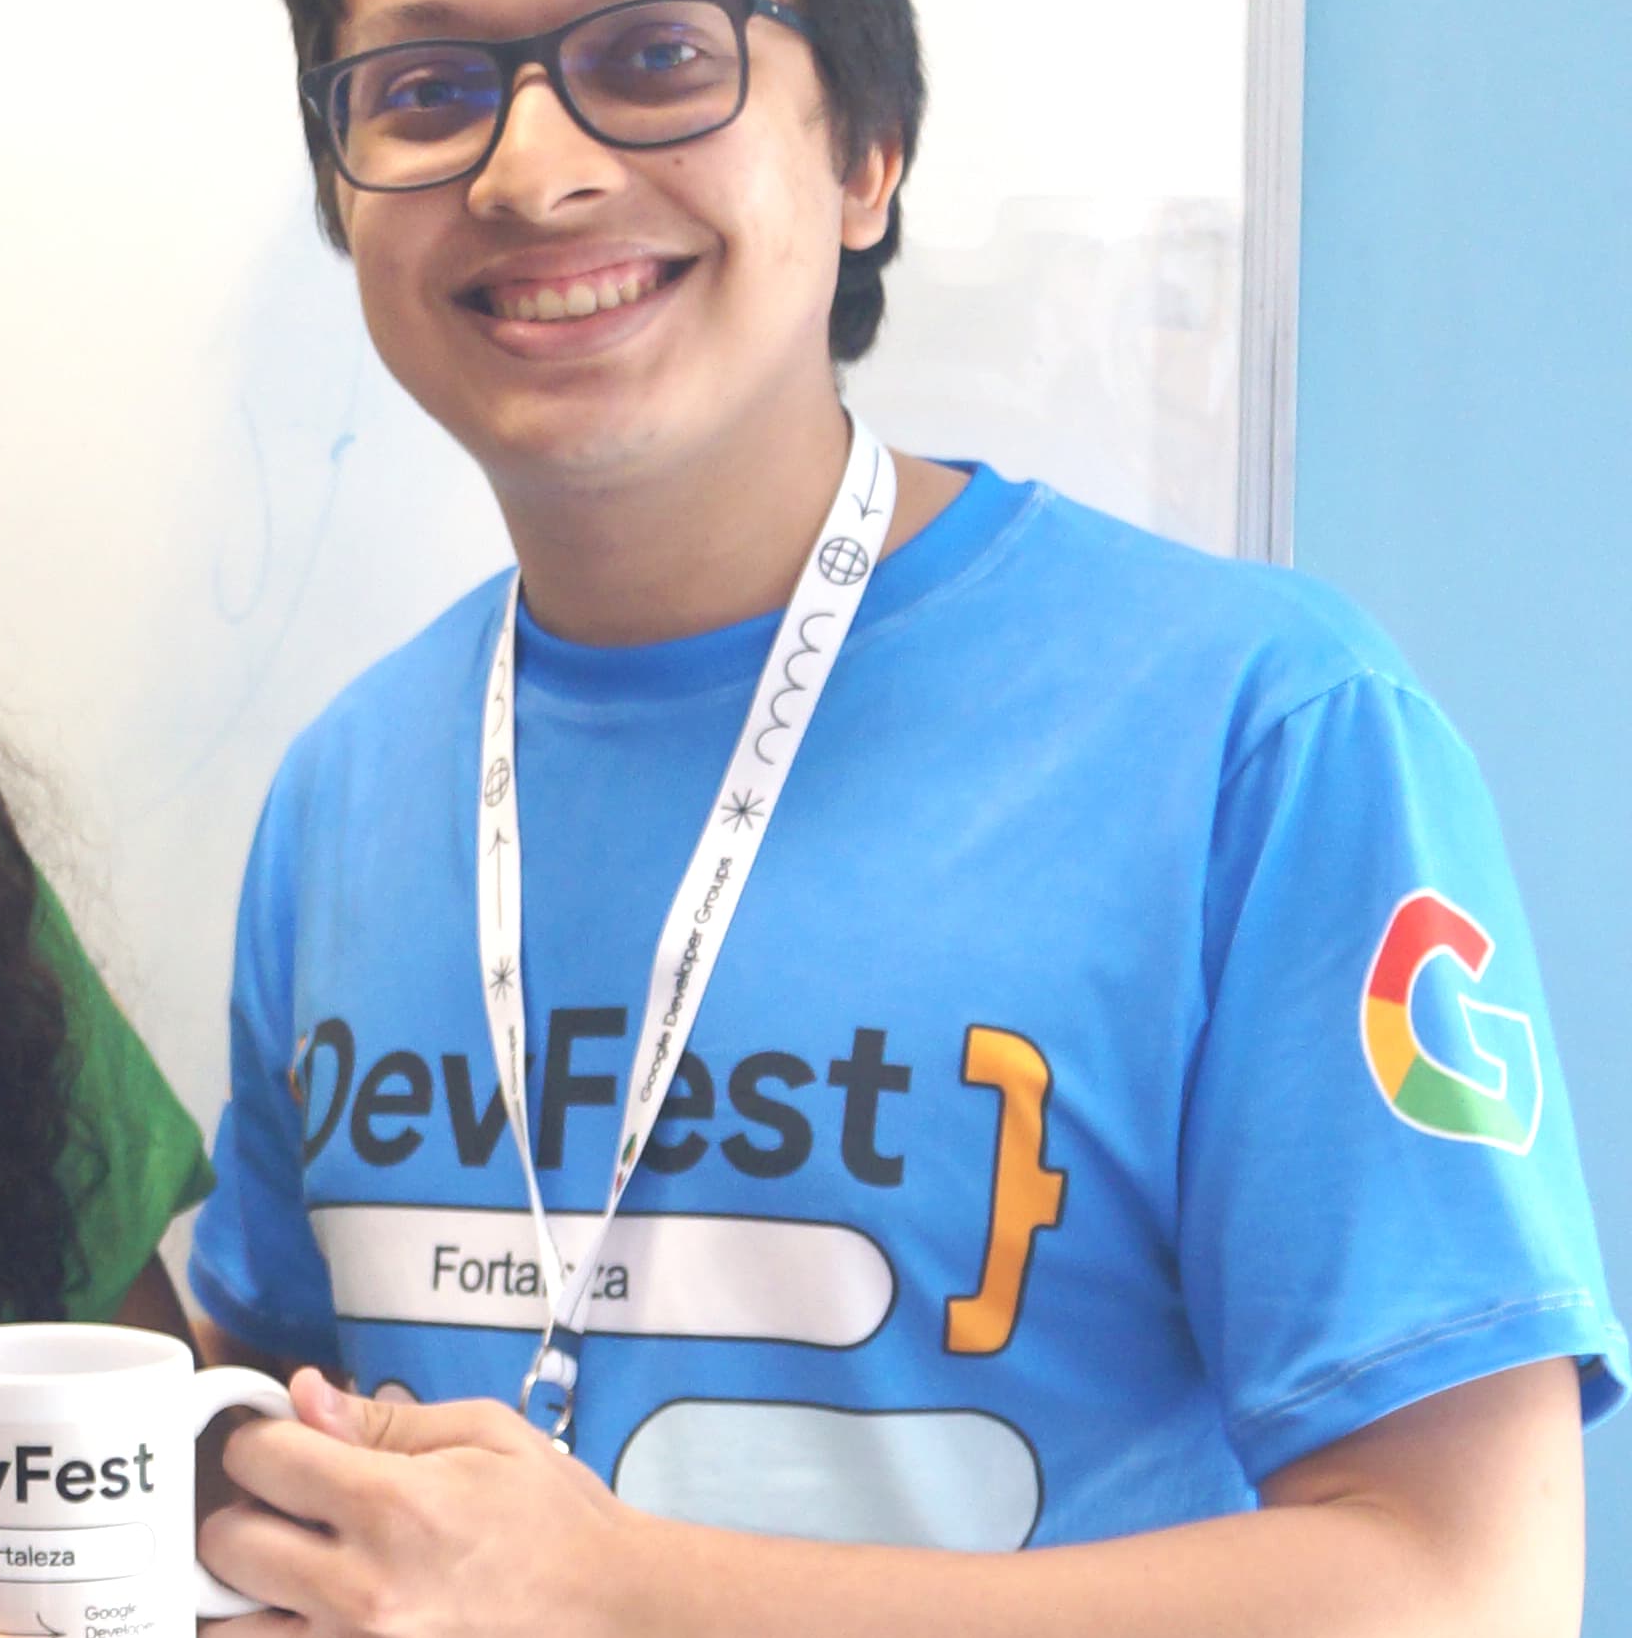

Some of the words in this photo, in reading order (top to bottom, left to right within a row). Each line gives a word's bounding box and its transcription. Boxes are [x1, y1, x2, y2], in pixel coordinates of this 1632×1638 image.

[640, 1031, 672, 1103] Google
[663, 928, 704, 1027] Developer
[694, 856, 733, 924] Groups
[304, 1006, 913, 1188] DevFest
[432, 1245, 630, 1301] Fortaa
